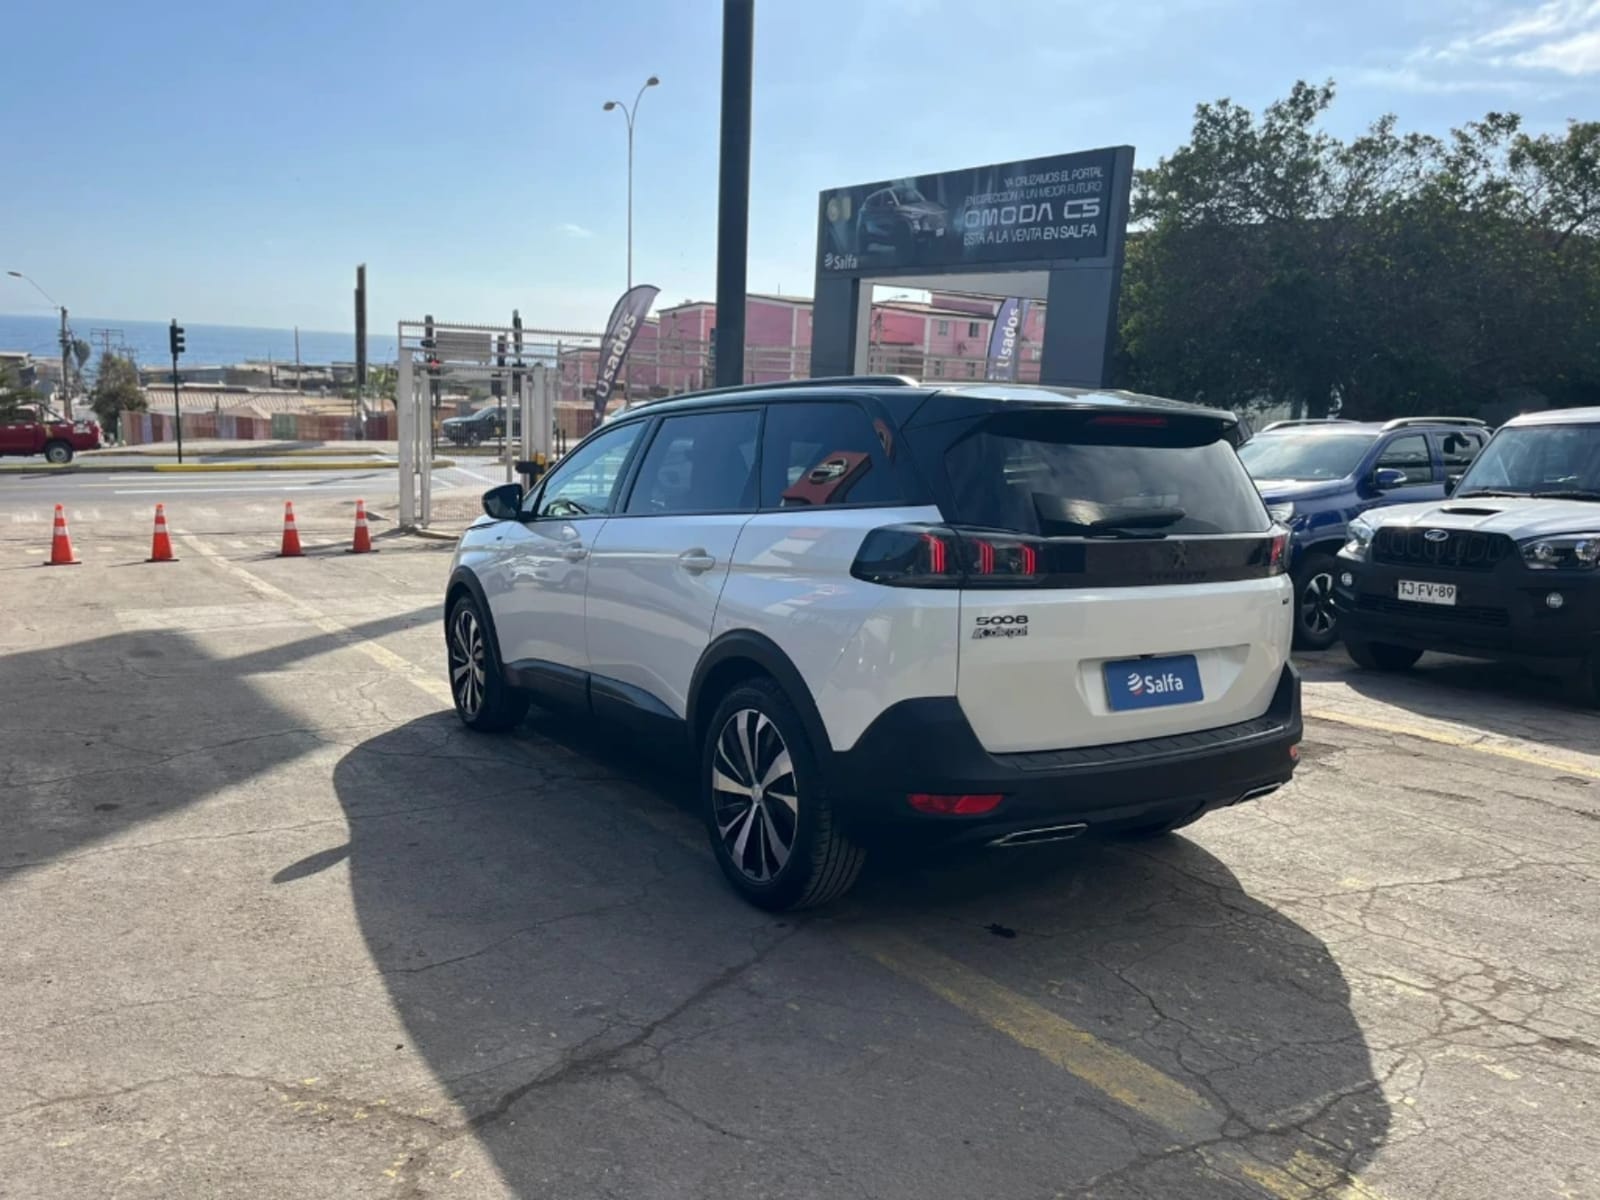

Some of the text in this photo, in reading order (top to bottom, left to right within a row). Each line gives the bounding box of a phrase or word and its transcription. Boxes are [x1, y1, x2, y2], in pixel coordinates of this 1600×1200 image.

[1071, 166, 1103, 180] PORTAL
[1067, 180, 1103, 195] FUTURO
[964, 203, 1053, 228] OMODA
[987, 230, 995, 244] A
[996, 230, 1009, 244] LA
[1010, 227, 1042, 243] VENTA
[1043, 226, 1059, 240] EN
[1060, 223, 1098, 239] SALFA
[834, 254, 857, 270] Salfa
[996, 308, 1019, 367] Usados
[596, 313, 637, 397] Usados
[976, 615, 1029, 626] 5008
[1144, 672, 1184, 694] Salfa
